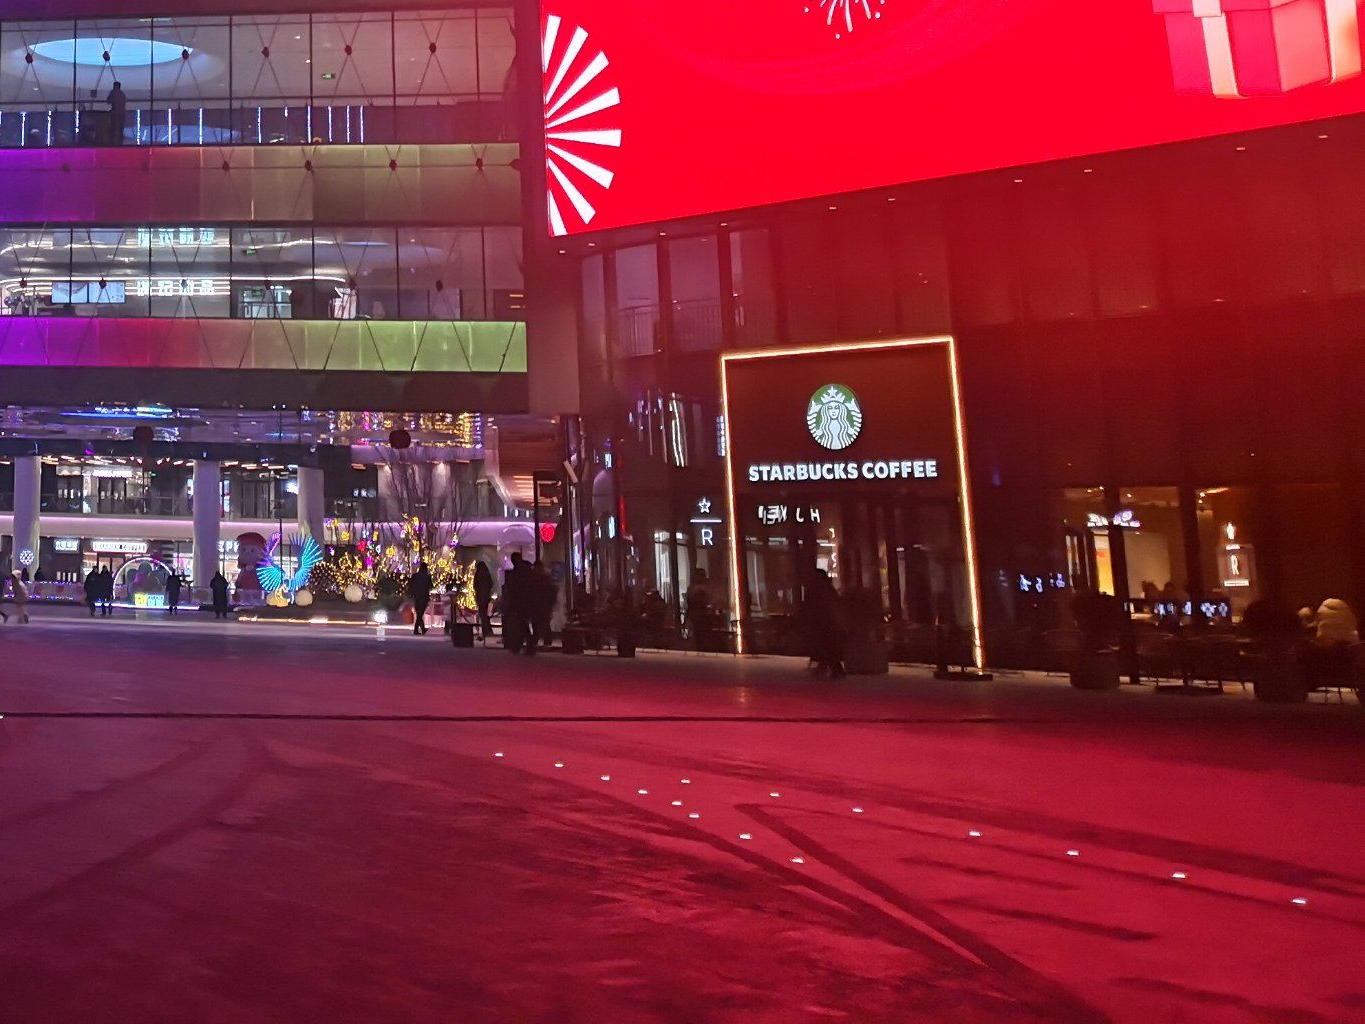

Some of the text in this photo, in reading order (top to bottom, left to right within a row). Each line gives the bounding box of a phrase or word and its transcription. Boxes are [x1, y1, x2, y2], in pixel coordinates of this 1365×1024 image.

[748, 460, 938, 482] STARBUCKS COFFEE
[701, 528, 714, 546] R
